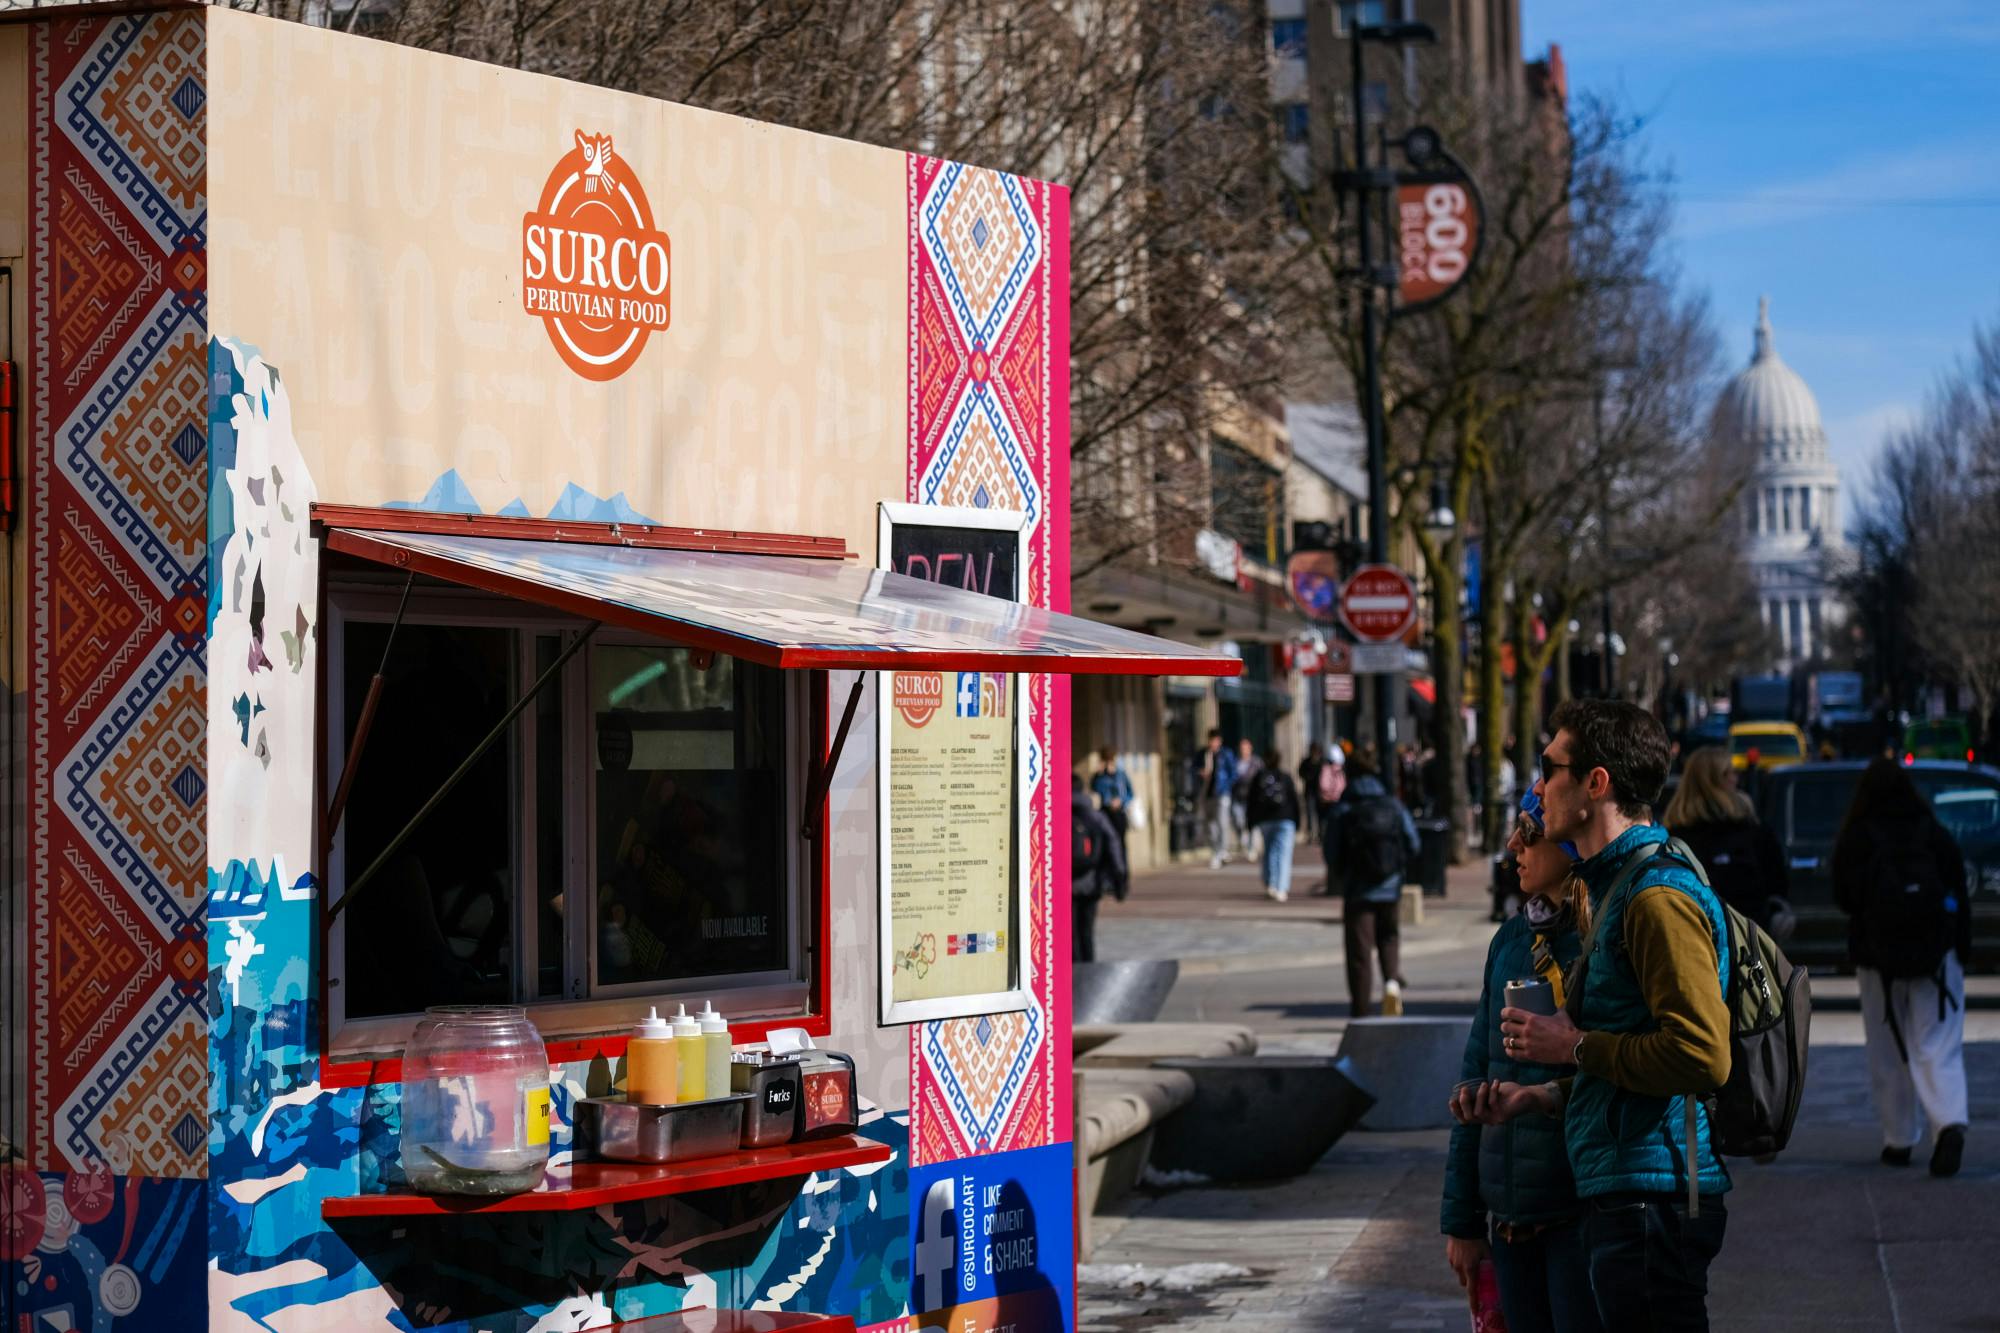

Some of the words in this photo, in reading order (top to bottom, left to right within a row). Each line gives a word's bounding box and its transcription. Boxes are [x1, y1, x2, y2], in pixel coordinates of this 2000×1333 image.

[1401, 202, 1426, 283] BLOCK
[1424, 183, 1468, 283] 600
[525, 224, 669, 296] SURCO
[526, 287, 615, 320] PERUVIAN
[619, 297, 667, 325] FOOD
[895, 675, 941, 695] SURCO
[702, 918, 721, 938] NOW
[723, 915, 768, 937] AVAILABLE
[768, 1089, 791, 1103] Forks
[821, 1094, 843, 1105] SURCO
[983, 1184, 1003, 1208] LIKE
[963, 1175, 976, 1292] @SURCOCART
[983, 1208, 1025, 1236] COMMENT
[984, 1244, 993, 1275] &
[995, 1237, 1035, 1273] SHARE
